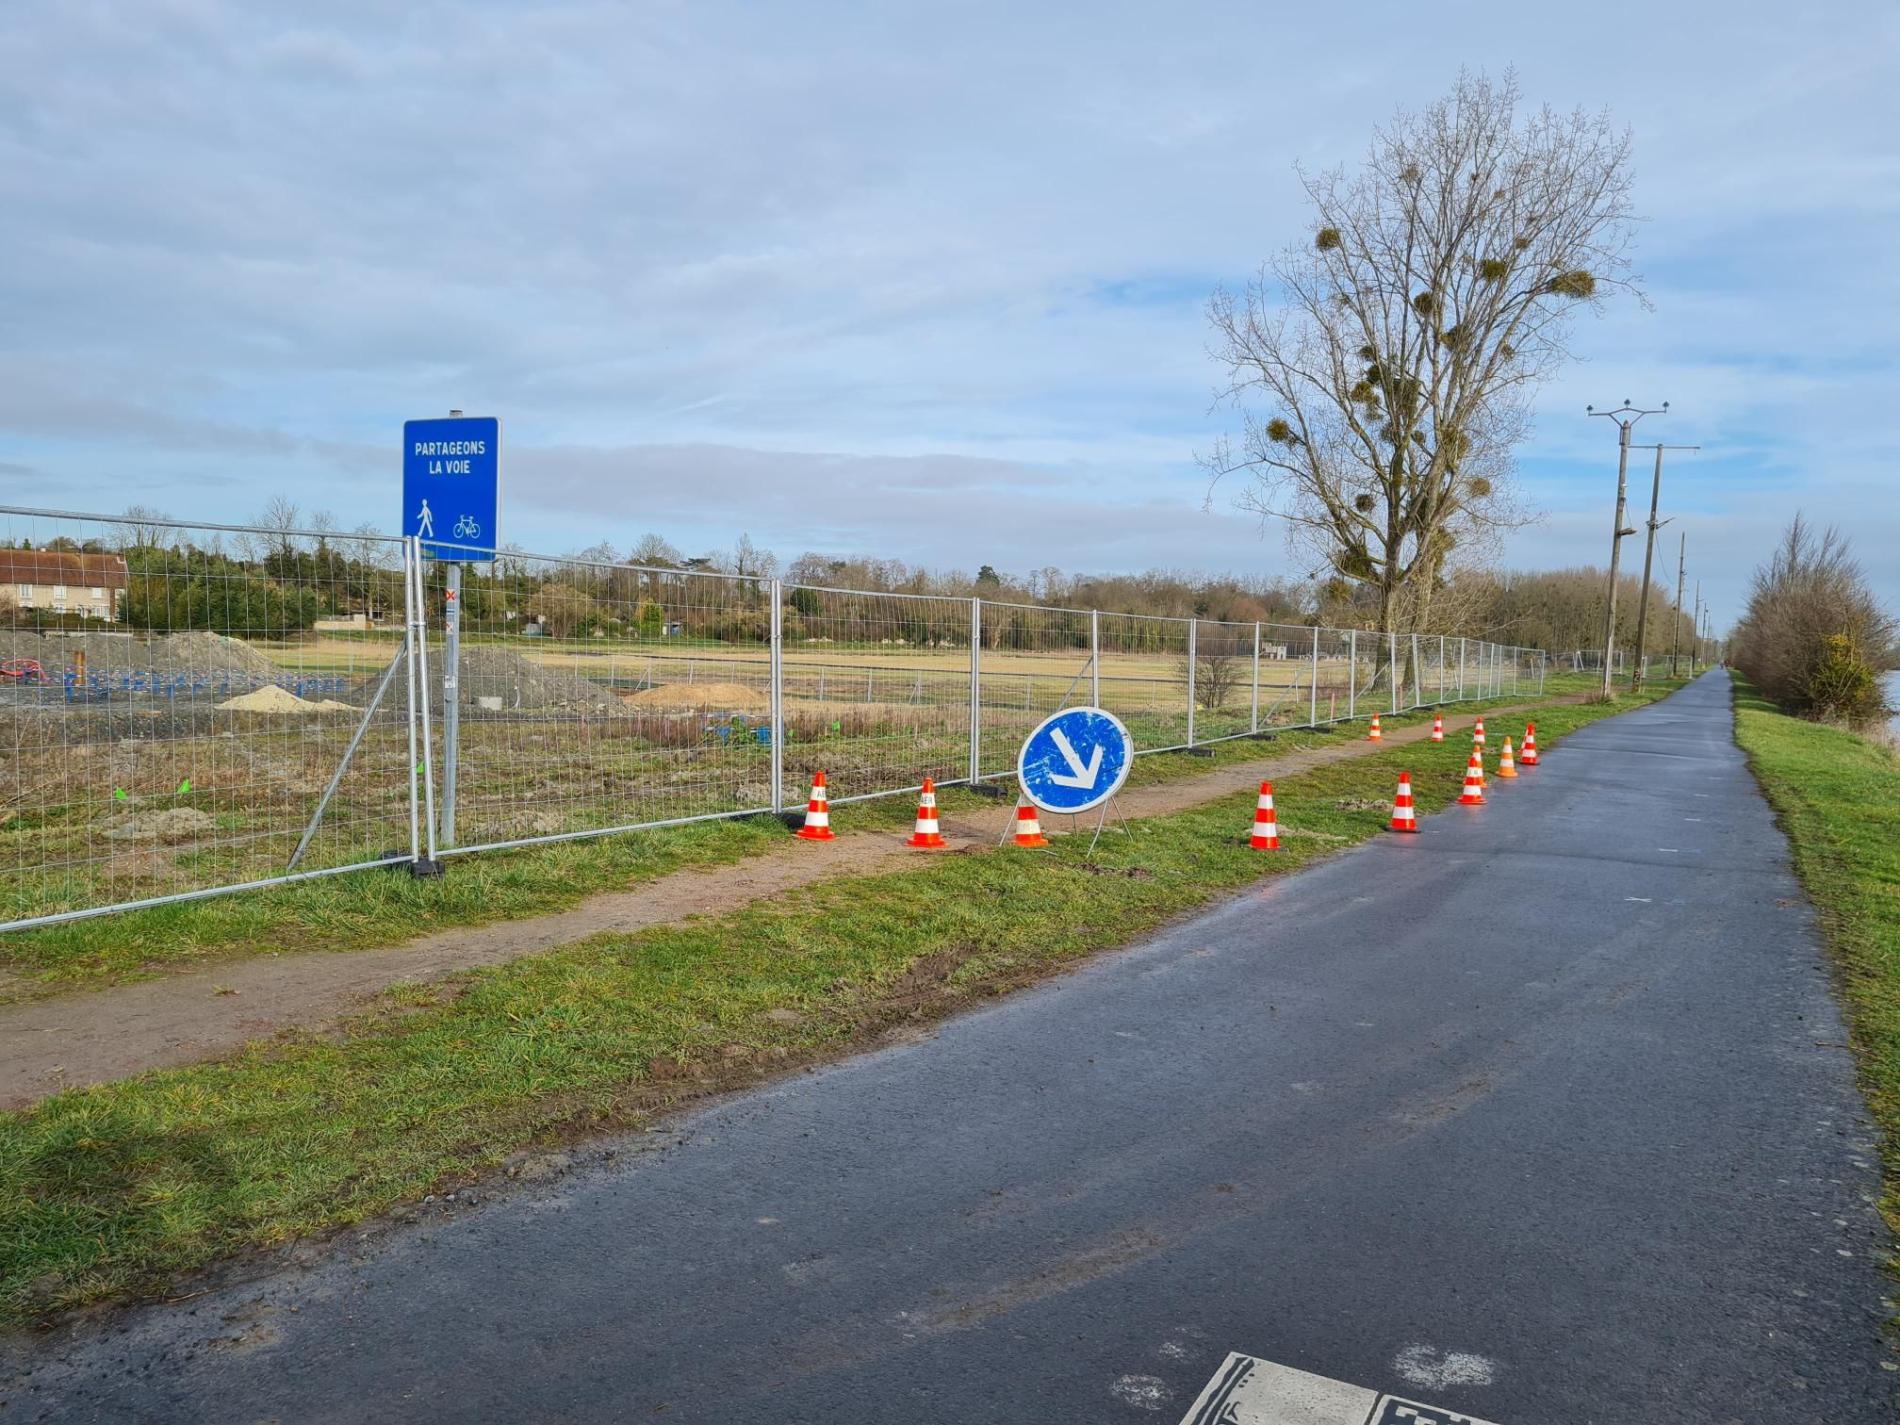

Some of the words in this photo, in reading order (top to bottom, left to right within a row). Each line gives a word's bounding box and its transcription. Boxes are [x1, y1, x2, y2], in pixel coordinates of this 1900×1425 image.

[415, 440, 485, 455] PARTAGEONS
[429, 461, 442, 473] LA
[446, 460, 470, 473] VOIE
